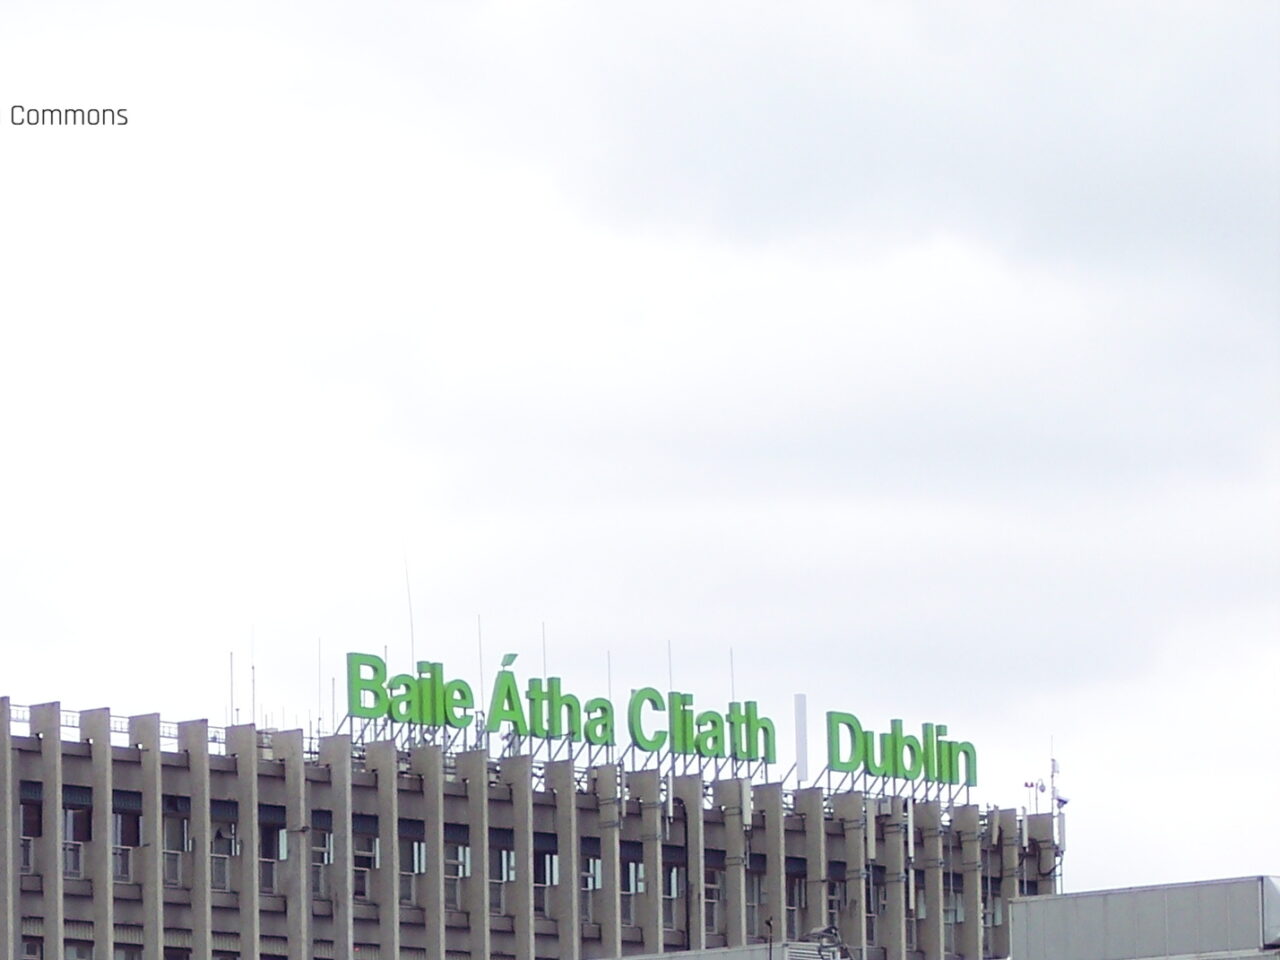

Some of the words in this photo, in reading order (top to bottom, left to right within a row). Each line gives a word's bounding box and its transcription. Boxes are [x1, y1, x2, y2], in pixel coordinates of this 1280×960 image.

[346, 651, 475, 728] Baile
[486, 652, 616, 747] Átha
[627, 686, 776, 765] Cliath
[825, 709, 977, 788] Dublin
